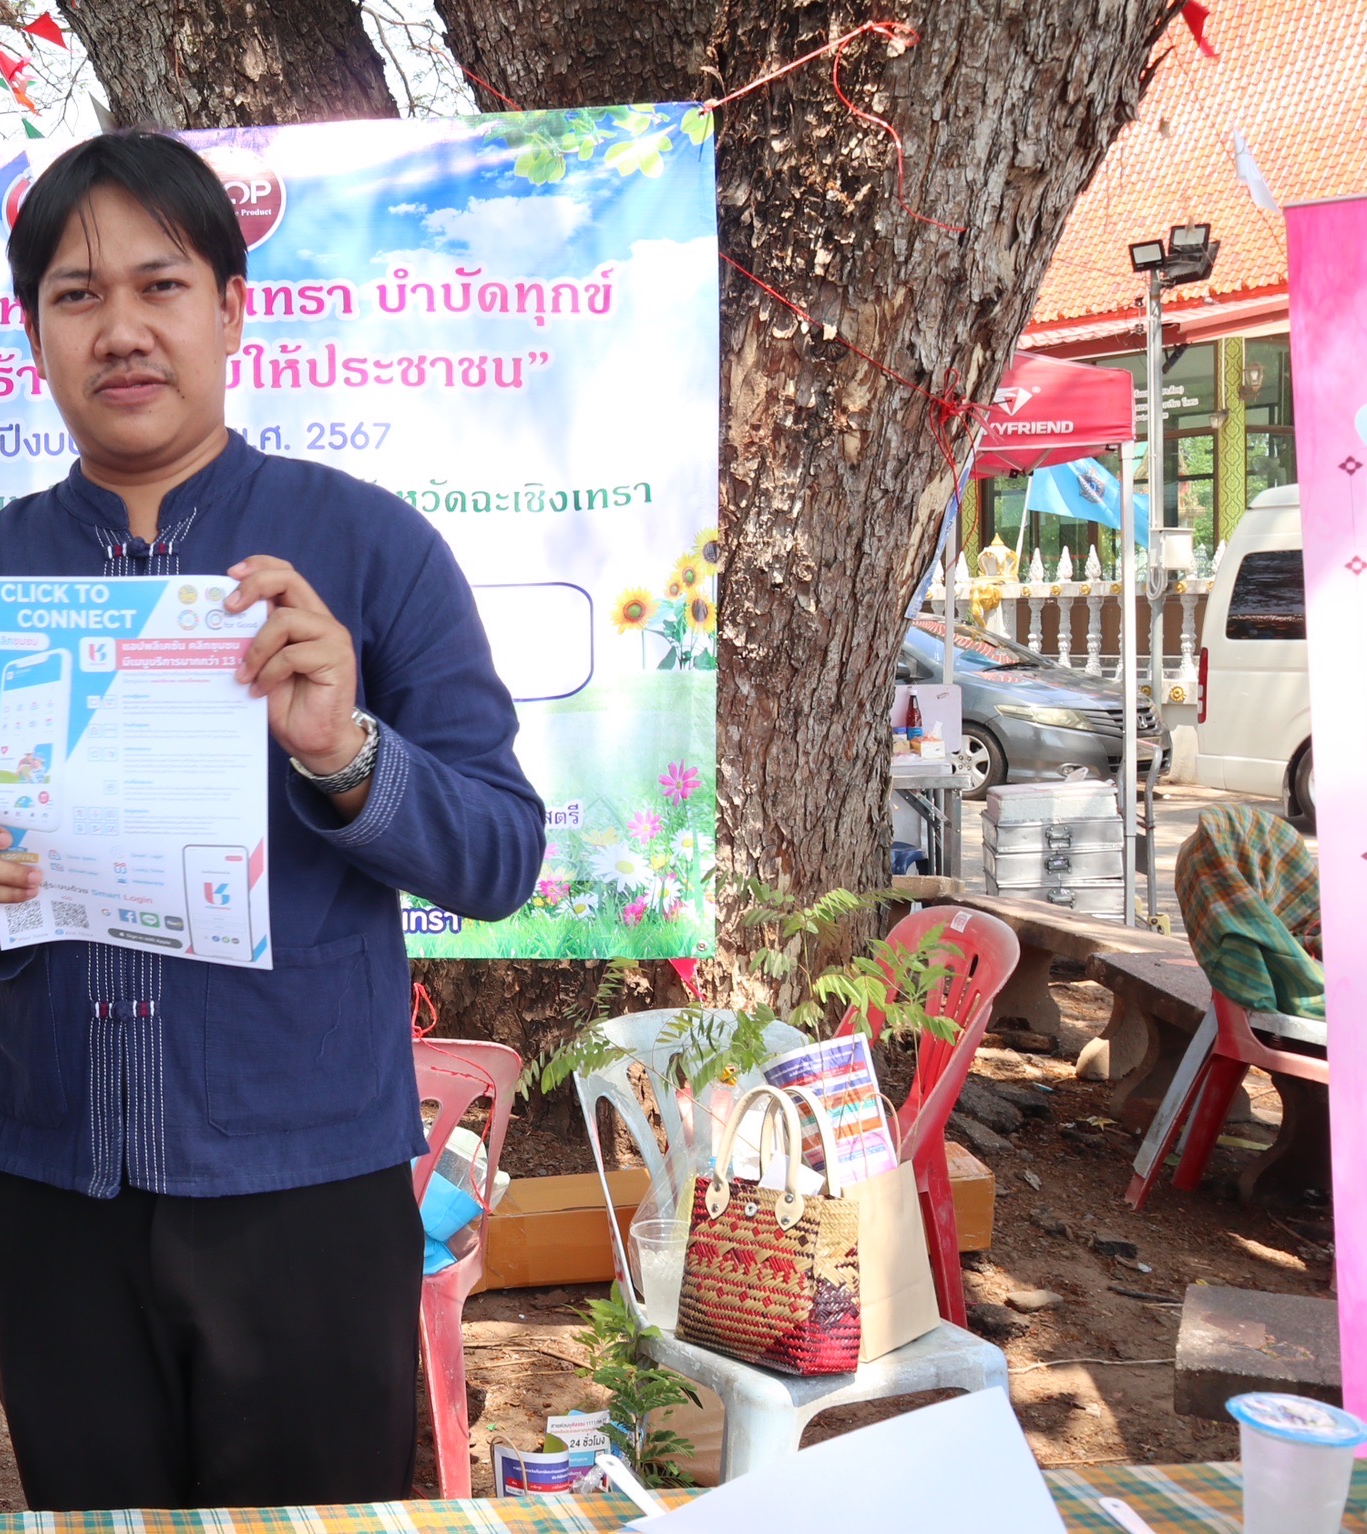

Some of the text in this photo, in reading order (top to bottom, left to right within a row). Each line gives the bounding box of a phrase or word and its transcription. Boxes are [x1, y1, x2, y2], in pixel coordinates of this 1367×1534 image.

[241, 208, 272, 217] Product
[377, 266, 614, 326] บำบัดทุกข์
[306, 421, 392, 451] 2567
[0, 583, 110, 604] CLICK TO
[17, 609, 137, 630] CONNECT
[222, 656, 235, 666] 13
[569, 1432, 606, 1448] 24 ชั่วโมง
